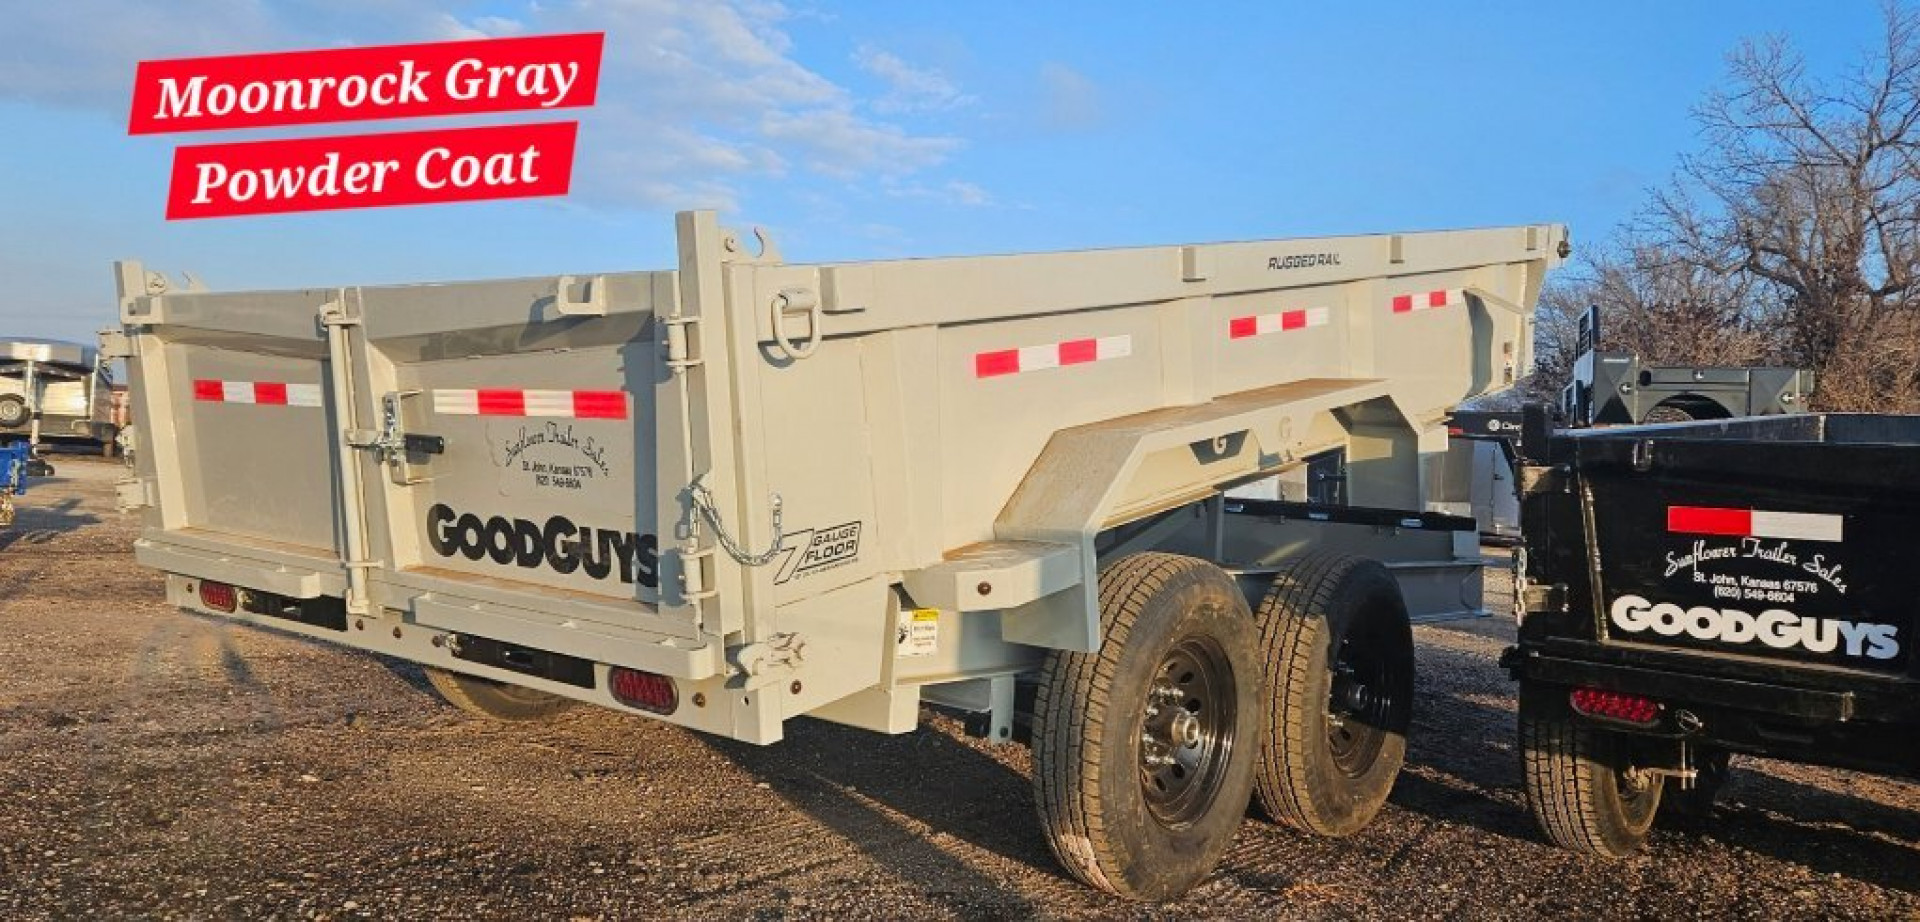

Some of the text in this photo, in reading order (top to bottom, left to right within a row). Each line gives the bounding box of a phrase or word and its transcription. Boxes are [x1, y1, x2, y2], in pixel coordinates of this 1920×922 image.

[1267, 252, 1341, 270] RUGGED RAIL
[813, 525, 858, 547] GAUGE
[805, 539, 856, 563] FLOOR
[1664, 536, 1848, 594] Sunflower Trailer Sales
[1740, 575, 1782, 590] Kansas
